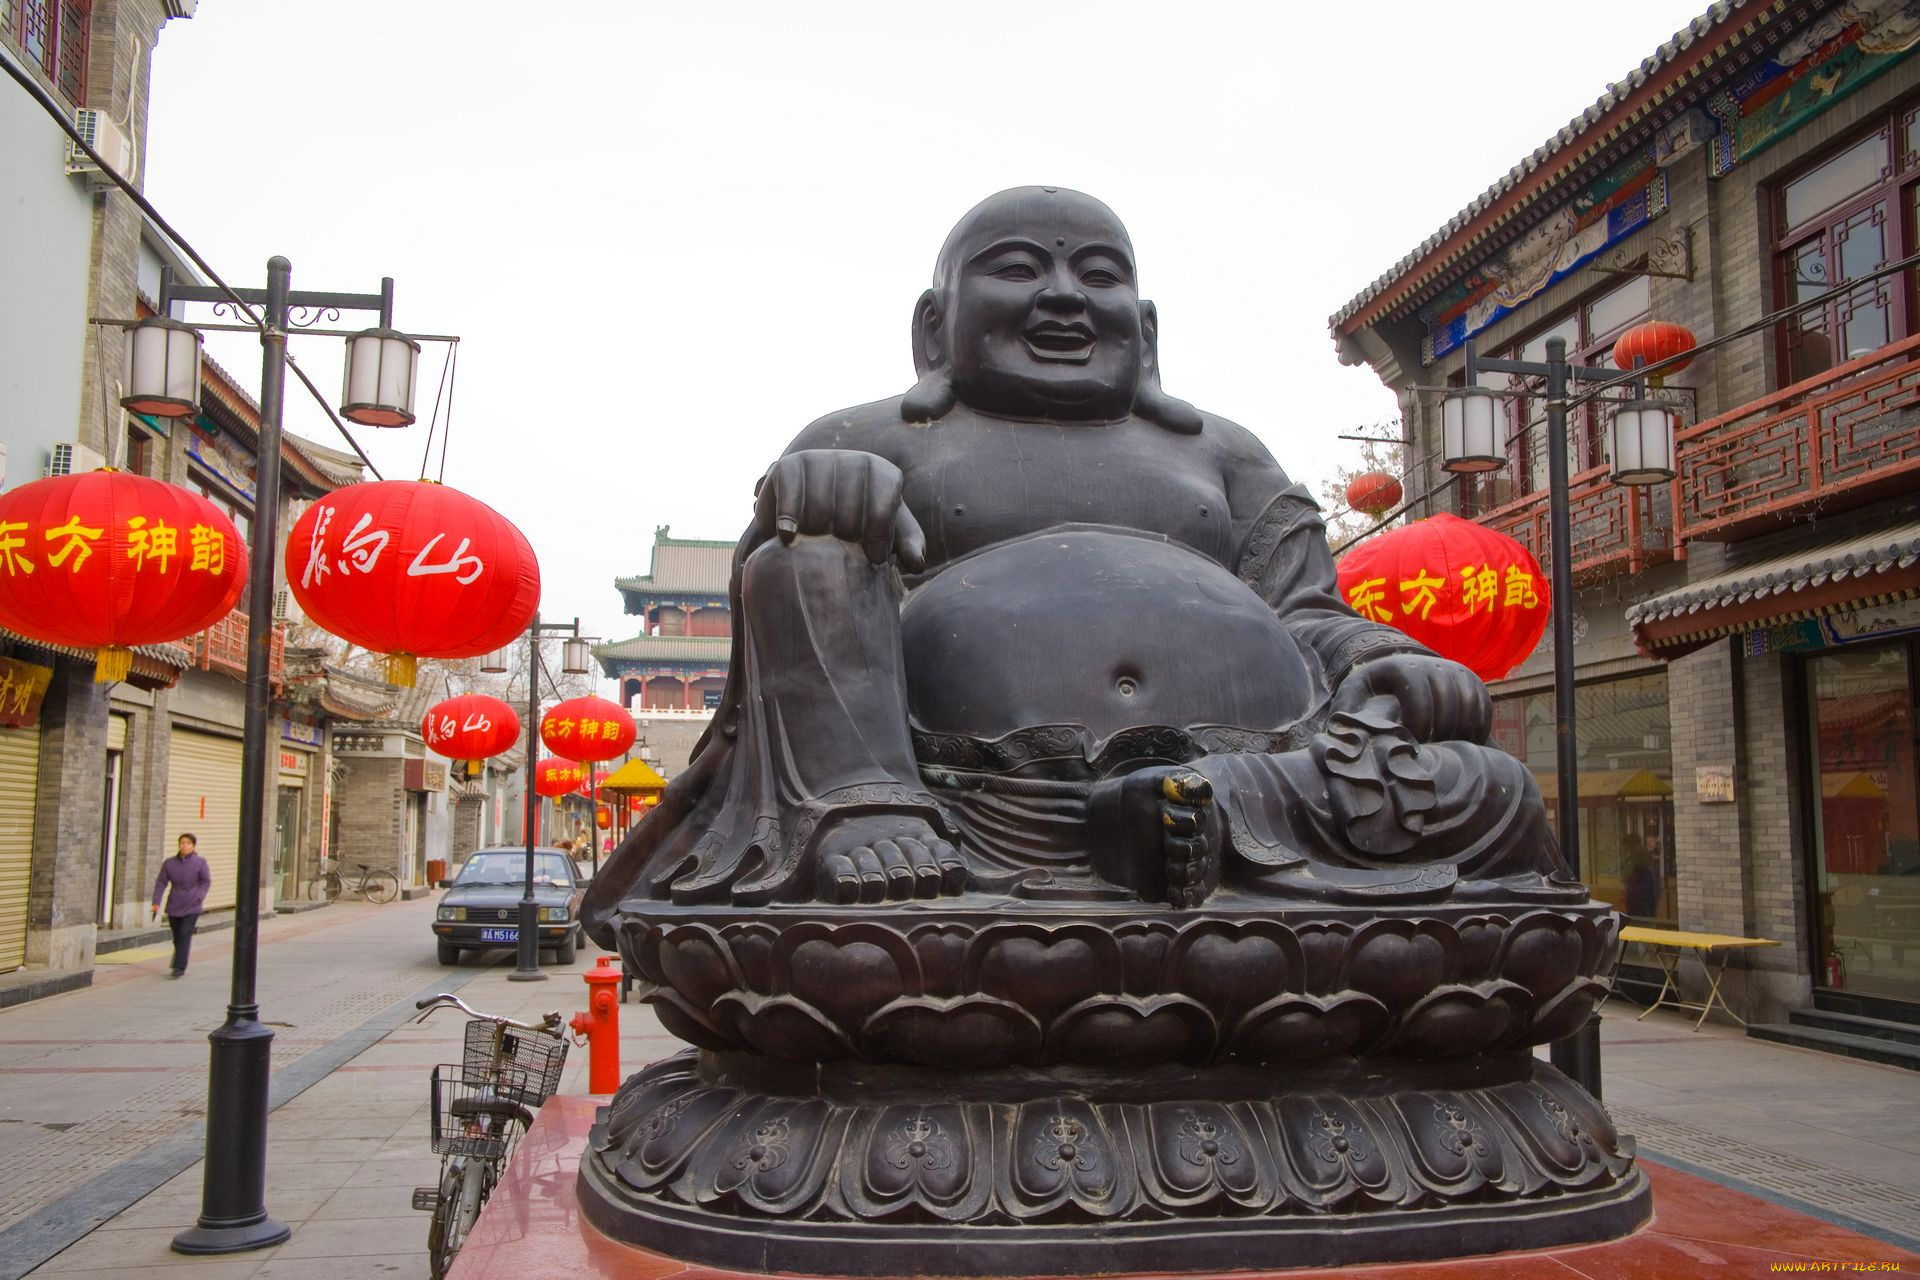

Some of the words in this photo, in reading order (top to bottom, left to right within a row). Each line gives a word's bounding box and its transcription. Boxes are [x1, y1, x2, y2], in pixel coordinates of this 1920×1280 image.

[0, 515, 224, 575] 东方神韵
[1349, 561, 1538, 622] 东方神韵
[544, 717, 620, 741] 东方神韵
